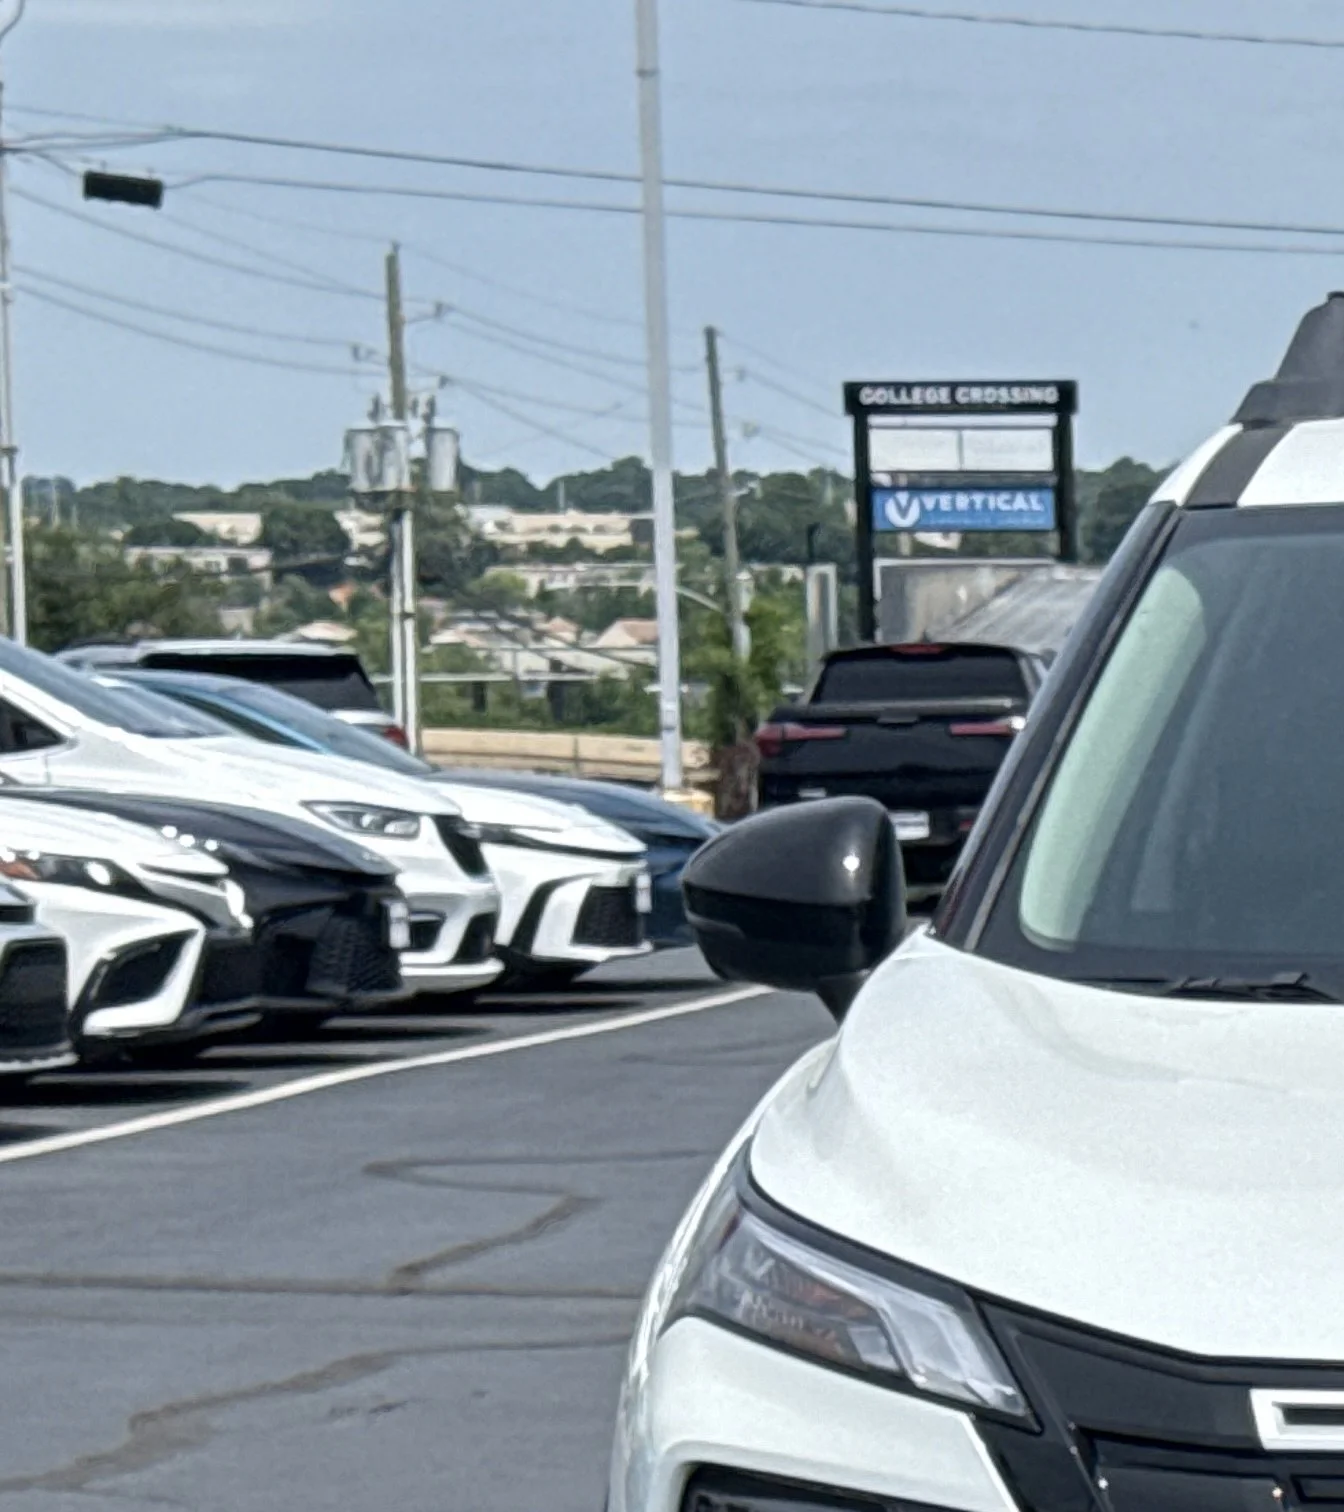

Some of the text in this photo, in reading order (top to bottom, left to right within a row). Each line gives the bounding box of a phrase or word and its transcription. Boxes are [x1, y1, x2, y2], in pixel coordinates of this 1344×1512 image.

[859, 386, 1060, 405] COLLEGE CROSSING
[920, 491, 1044, 512] VERTICAL
